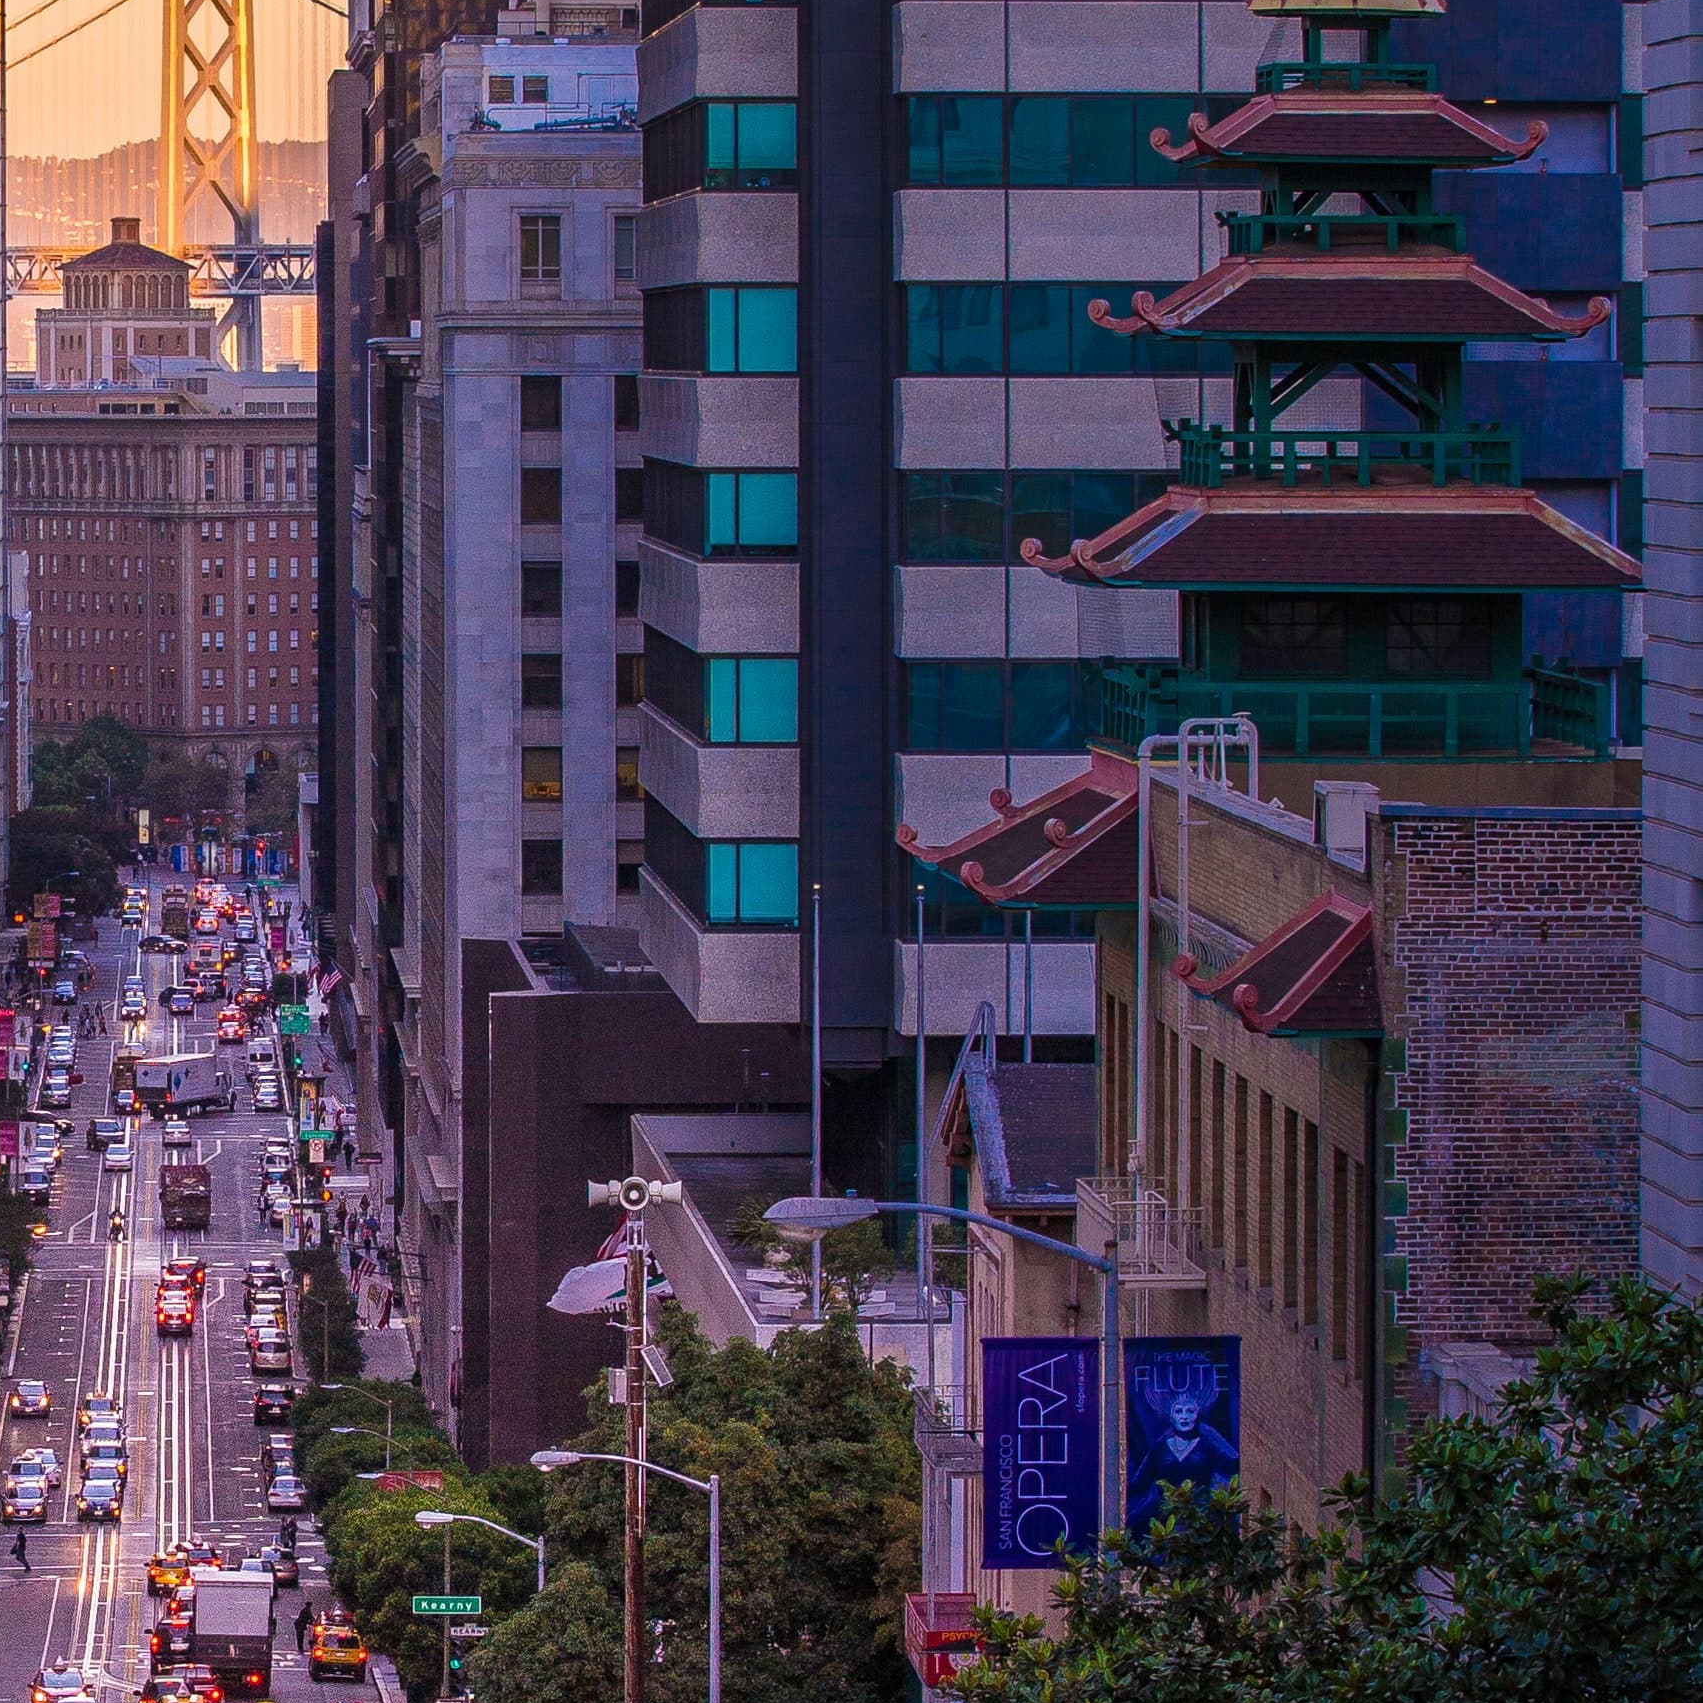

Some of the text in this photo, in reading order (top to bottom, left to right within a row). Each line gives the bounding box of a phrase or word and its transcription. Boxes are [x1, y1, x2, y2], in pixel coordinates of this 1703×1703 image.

[1153, 1351, 1211, 1363] THE MAGIC
[1134, 1363, 1231, 1393] FLUTE
[1016, 1353, 1069, 1556] OPERA
[999, 1434, 1013, 1550] SAN FRANCISCO
[421, 1601, 472, 1611] Kearny
